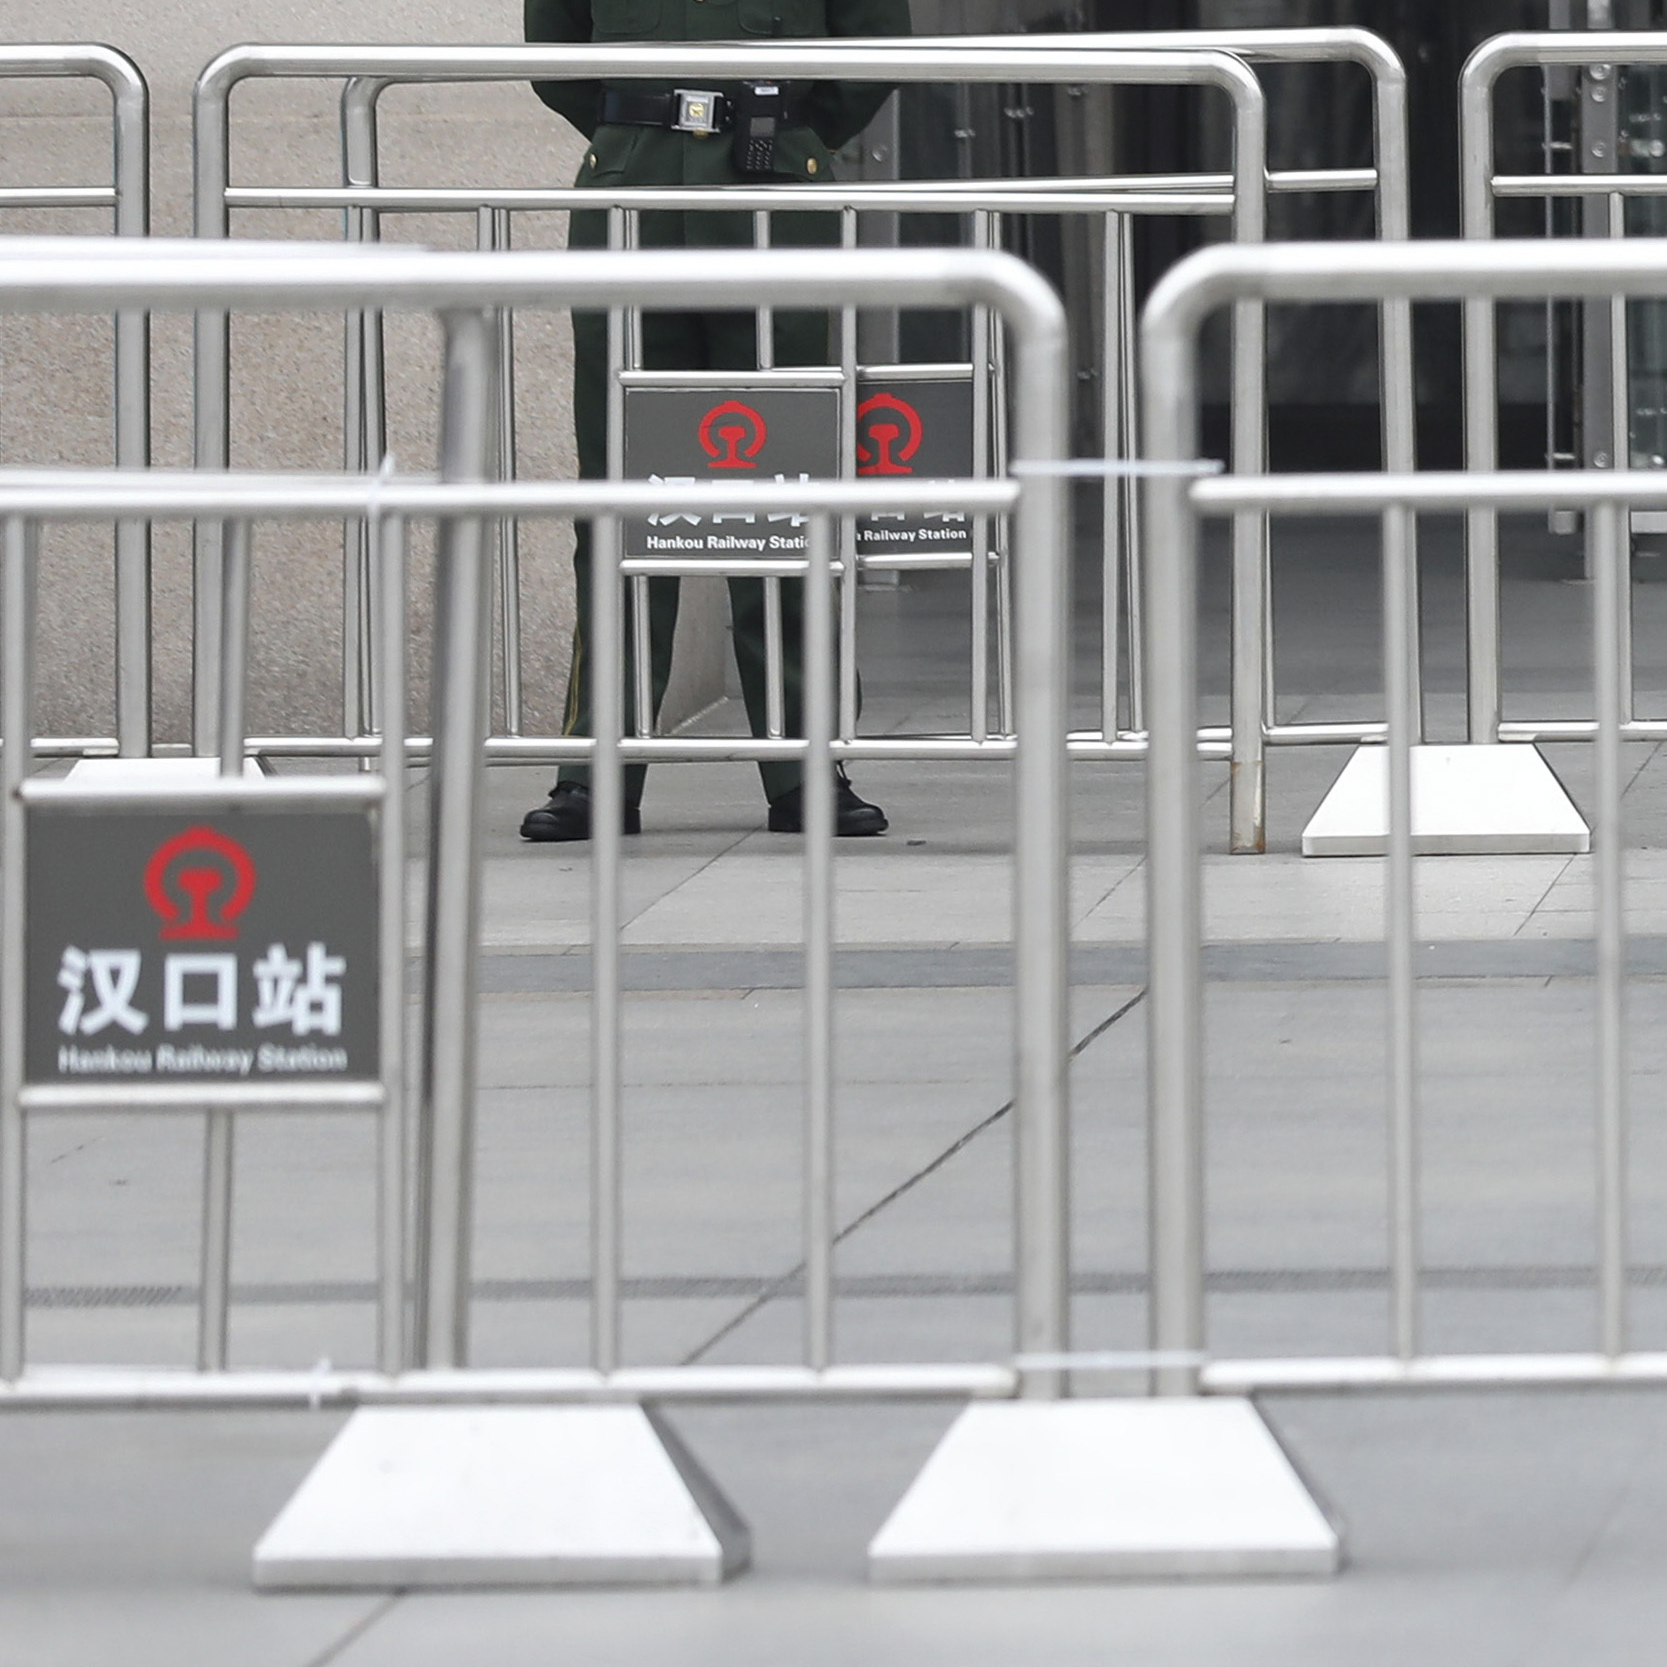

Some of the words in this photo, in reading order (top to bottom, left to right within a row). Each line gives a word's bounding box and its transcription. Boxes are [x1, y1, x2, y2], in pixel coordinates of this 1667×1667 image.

[646, 535, 704, 550] Hankou
[706, 535, 767, 552] Railway
[863, 529, 916, 543] Railway
[918, 527, 967, 541] Station
[57, 941, 348, 1036] 汉口站
[57, 1045, 153, 1073] Hankou
[155, 1043, 255, 1076] Railway
[256, 1042, 349, 1073] Station
